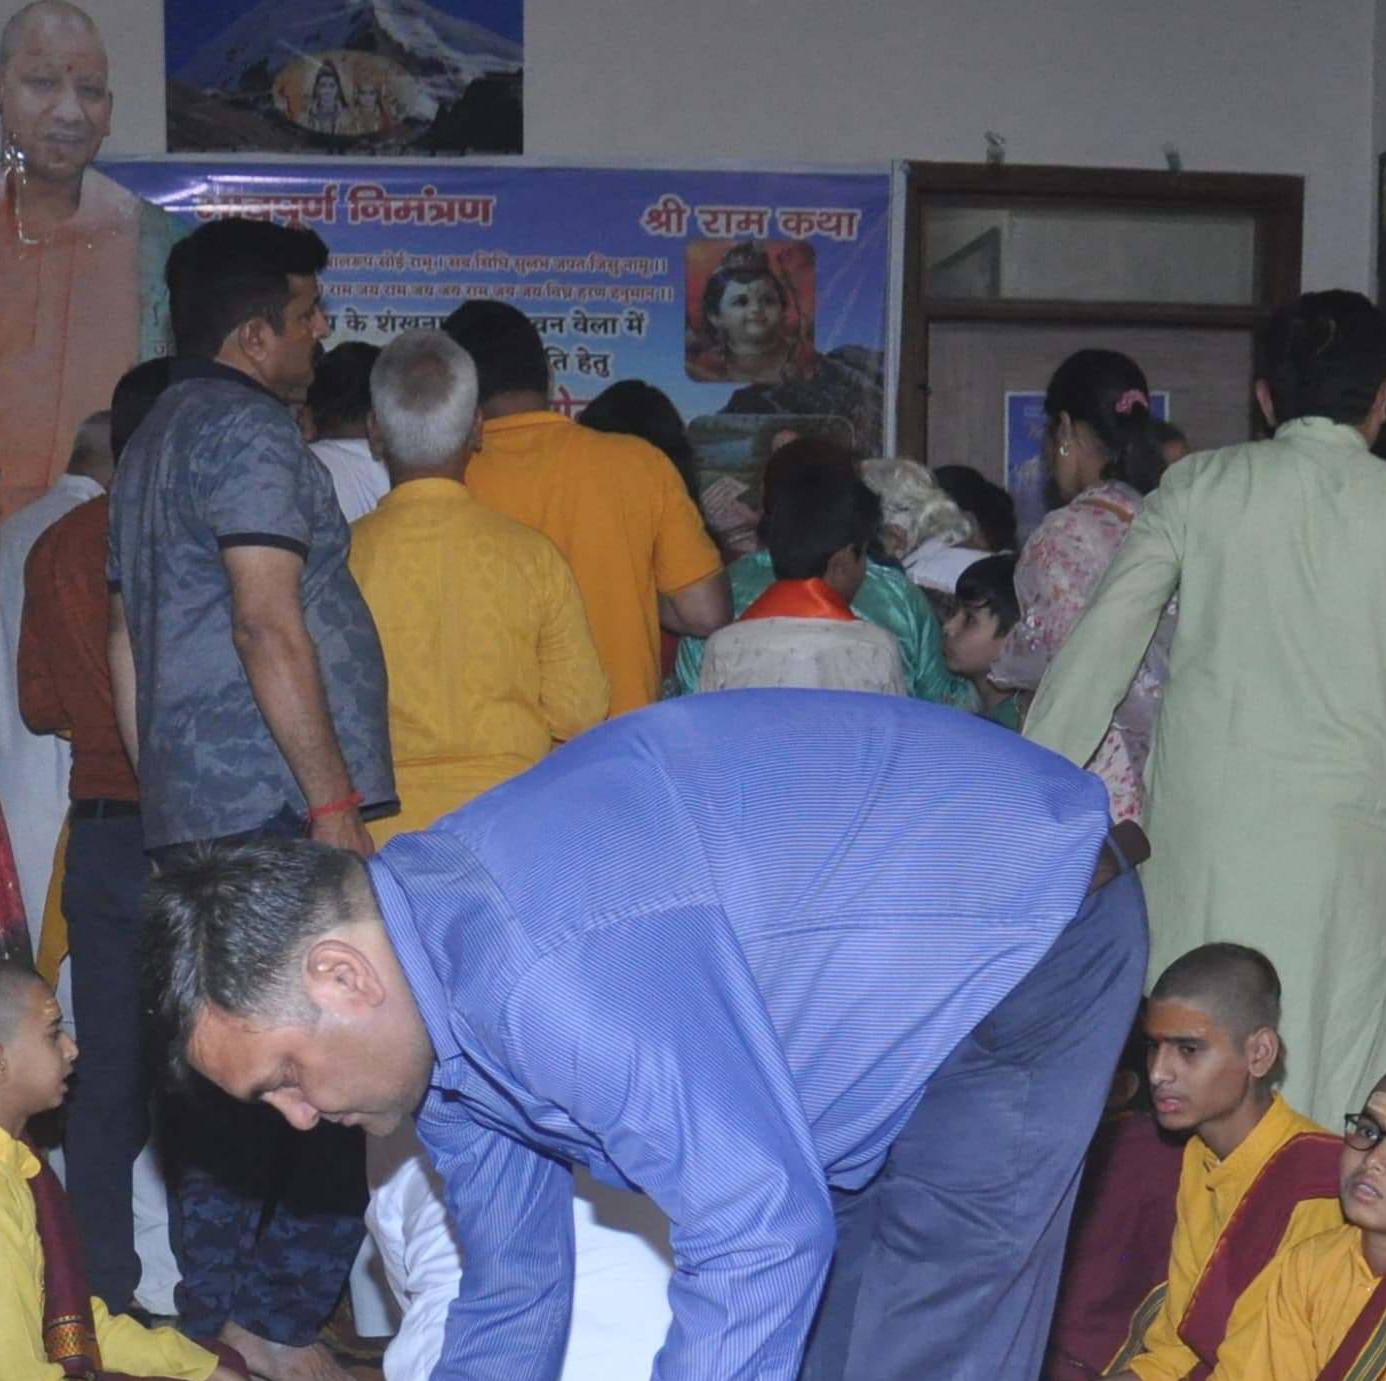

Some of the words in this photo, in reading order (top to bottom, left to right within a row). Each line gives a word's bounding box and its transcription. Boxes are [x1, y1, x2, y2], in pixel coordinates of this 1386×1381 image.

[348, 184, 497, 225] निमंत्रण
[644, 196, 686, 235] श्री
[698, 207, 768, 236] राम
[779, 209, 860, 238] कथा
[345, 307, 368, 332] के
[571, 308, 619, 336] वेला
[625, 309, 646, 336] में
[575, 348, 611, 379] हेतु
